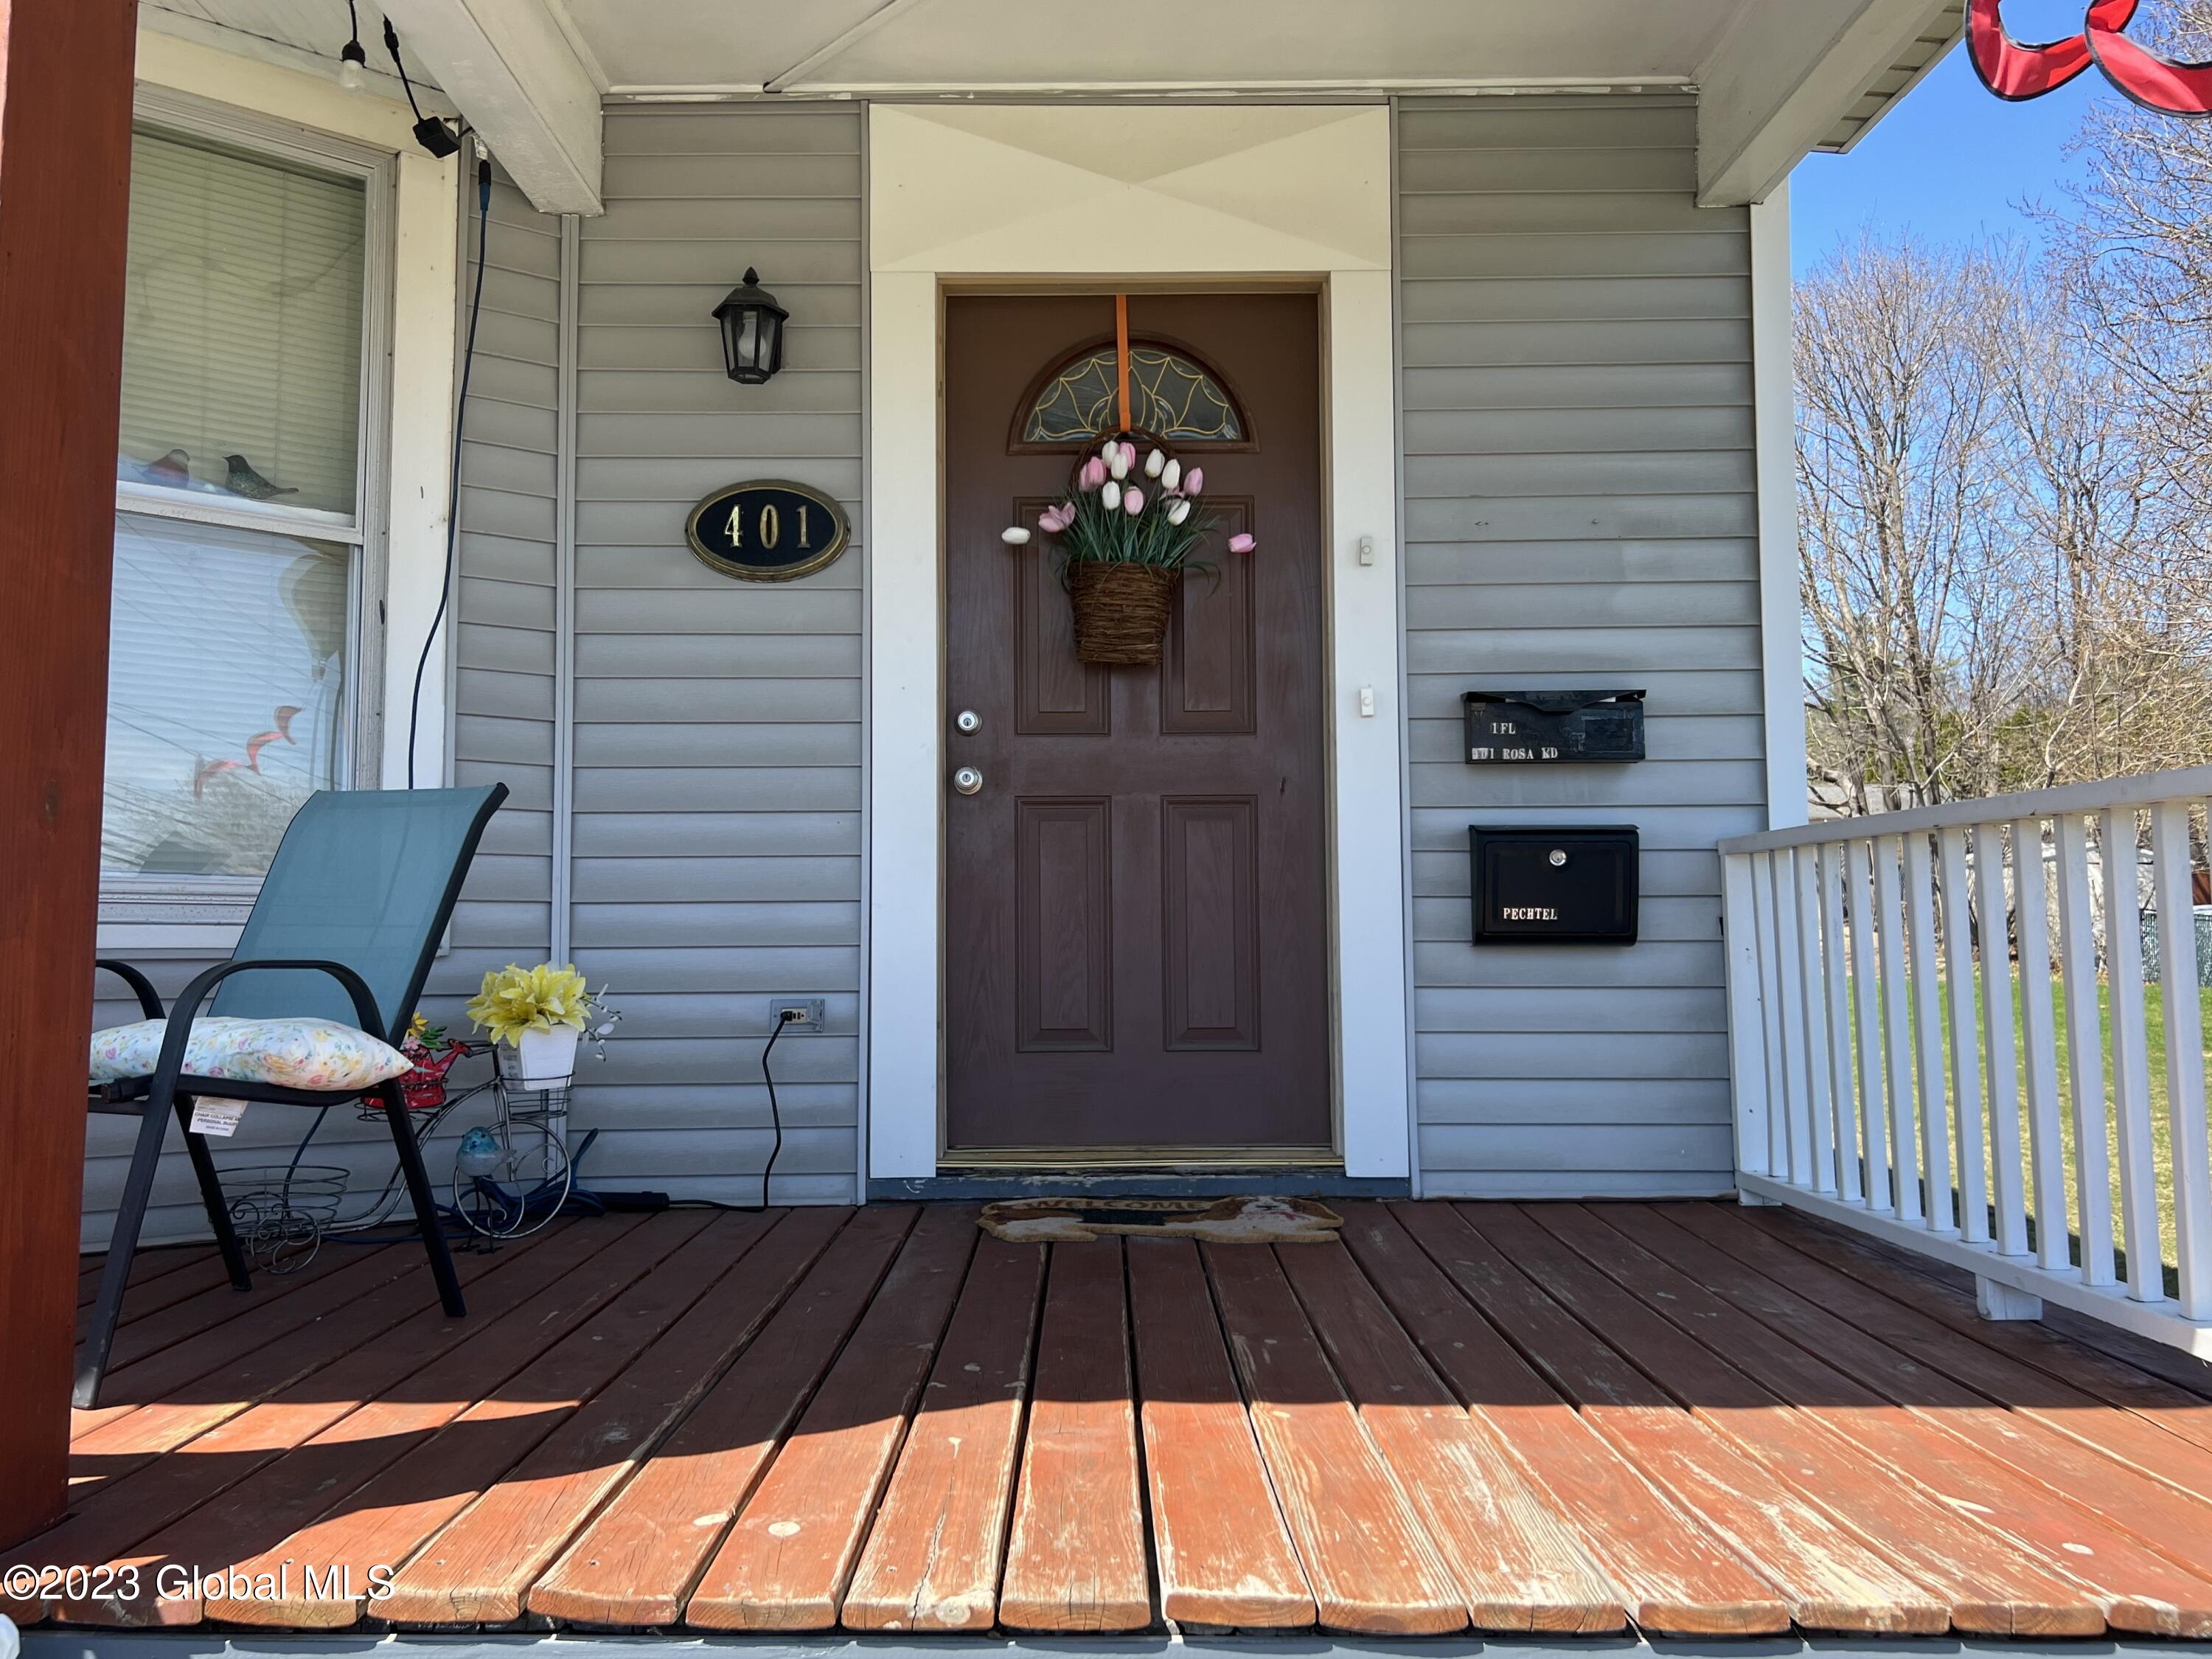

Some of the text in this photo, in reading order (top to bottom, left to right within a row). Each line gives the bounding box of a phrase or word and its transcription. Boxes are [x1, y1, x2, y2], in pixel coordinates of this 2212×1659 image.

[724, 504, 811, 549] 401
[1502, 747, 1534, 760] ROSA
[1503, 908, 1558, 920] PECHTEL
[1023, 1199, 1205, 1211] WELCOME
